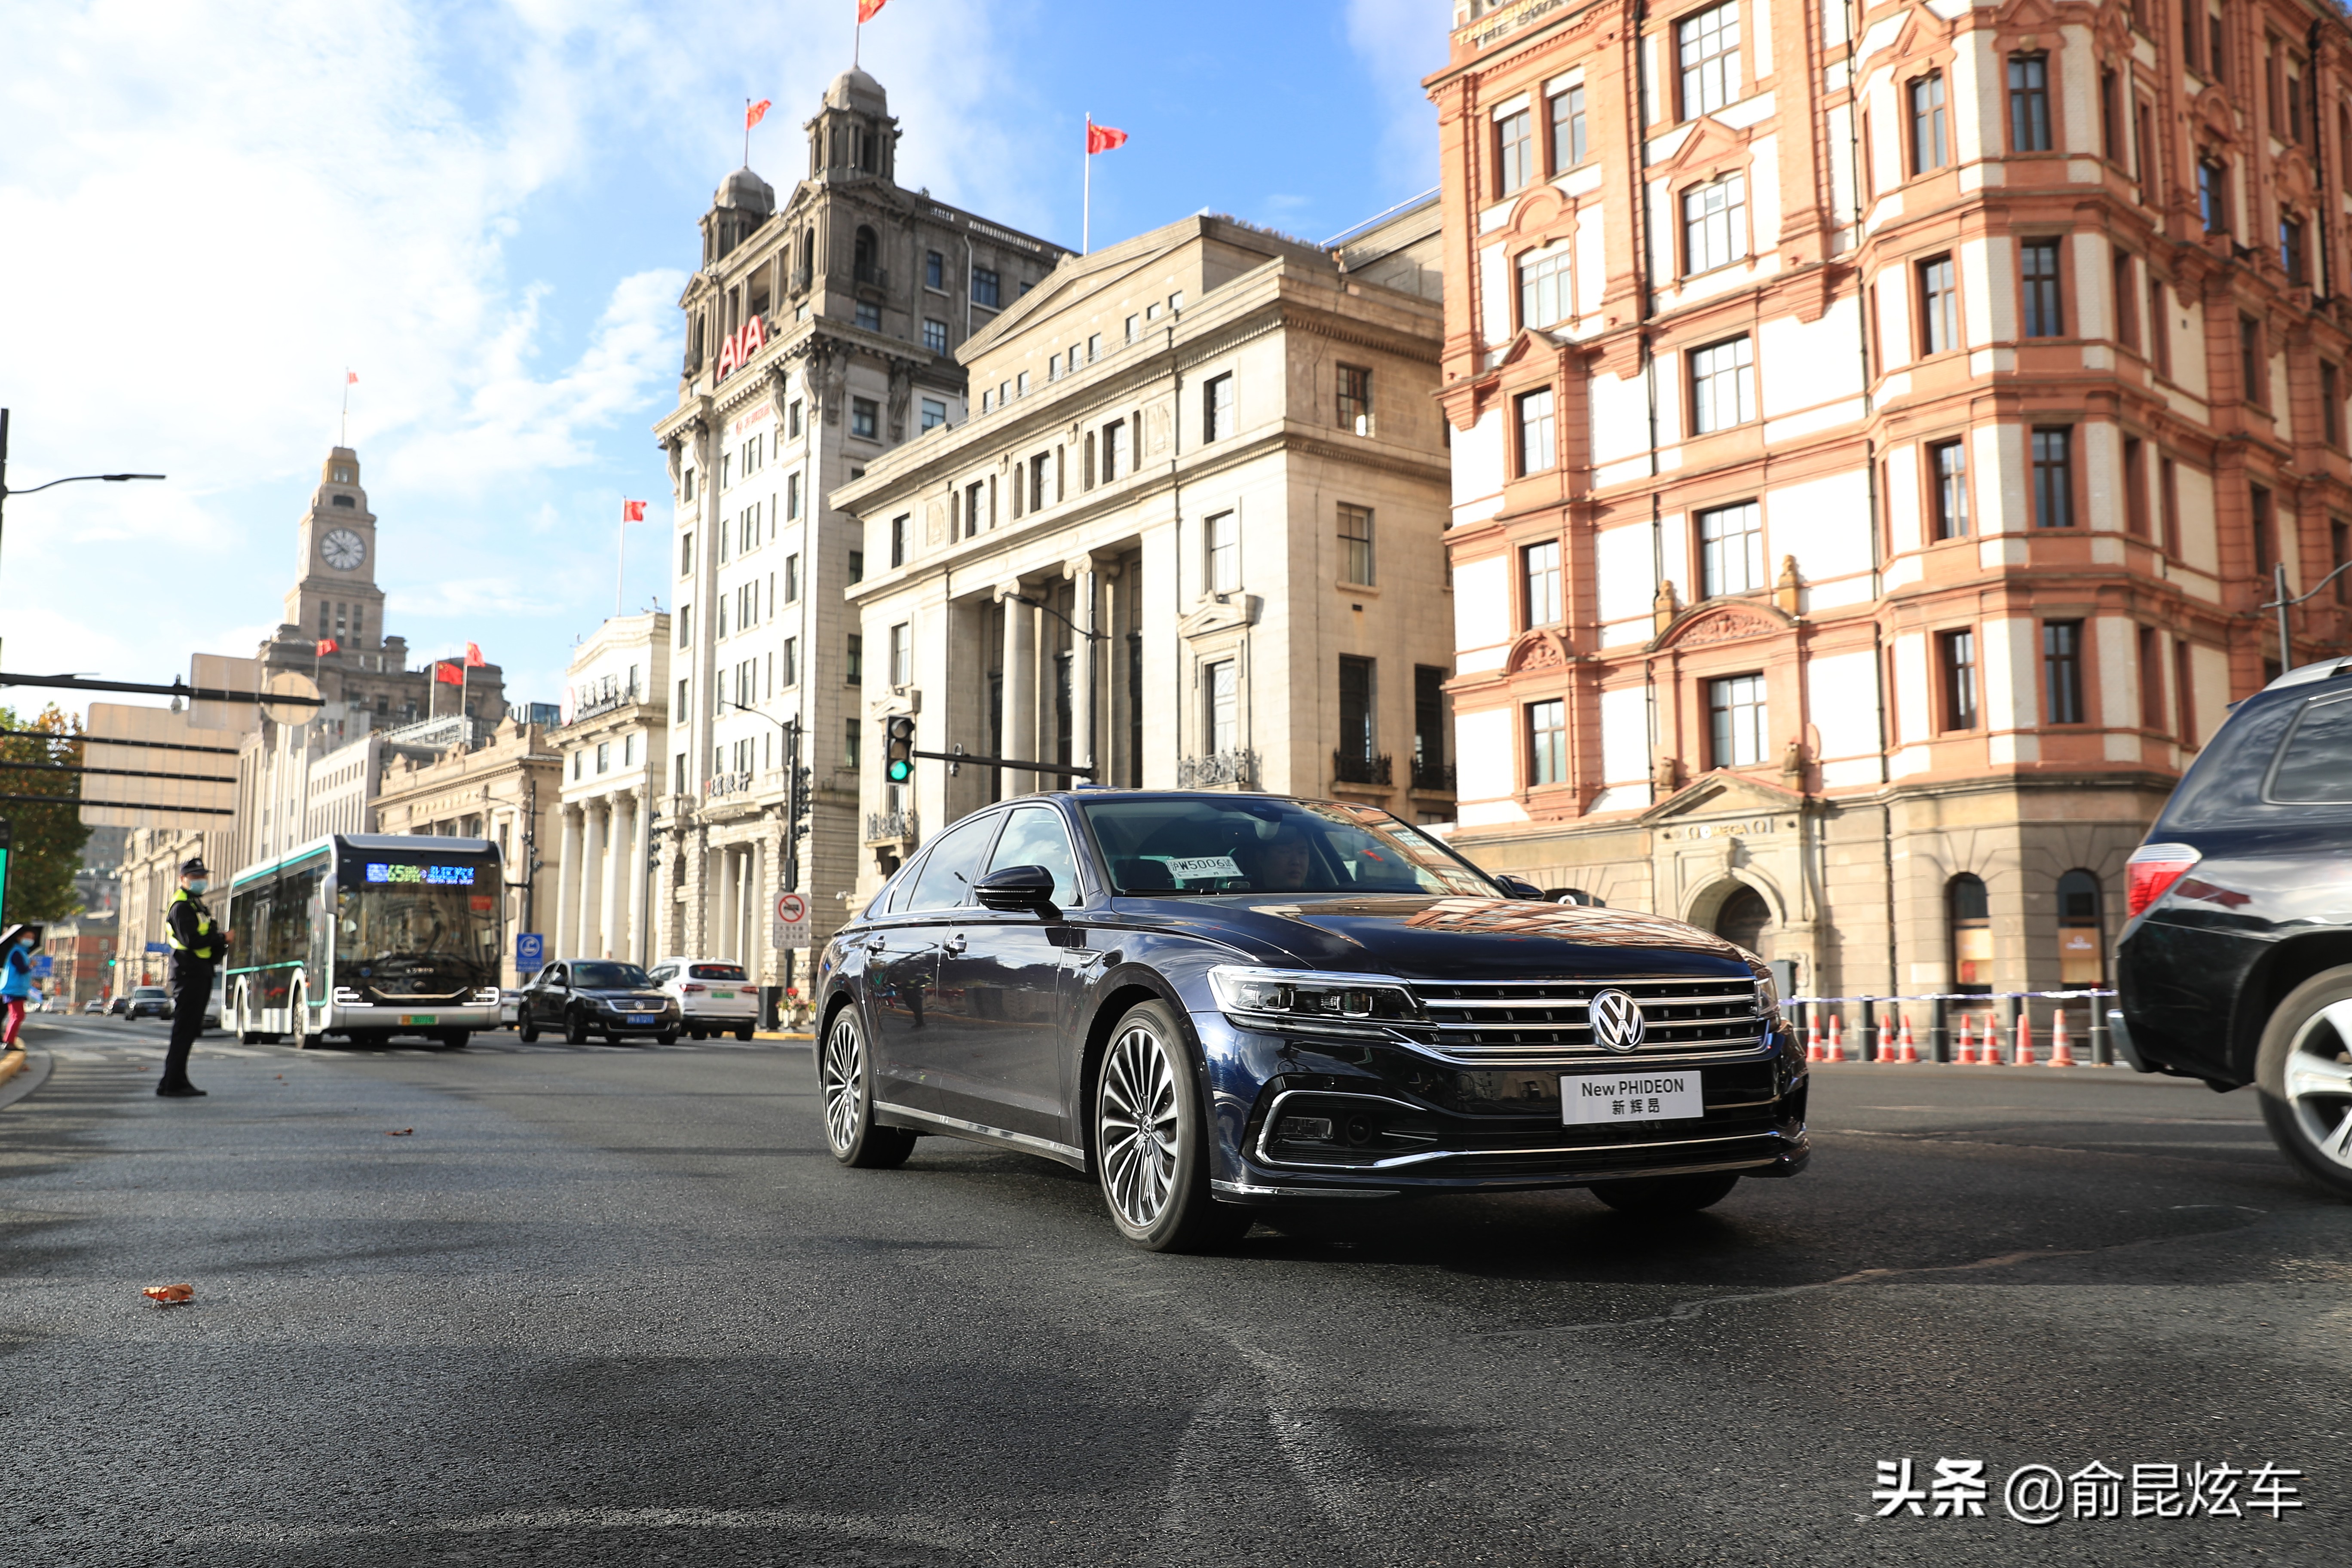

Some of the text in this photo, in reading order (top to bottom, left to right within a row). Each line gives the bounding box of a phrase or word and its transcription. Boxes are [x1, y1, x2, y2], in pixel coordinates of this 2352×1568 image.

[716, 314, 764, 381] AIA
[1582, 1078, 1684, 1096] New PHIDEON
[1612, 1098, 1660, 1115] 新辉昂
